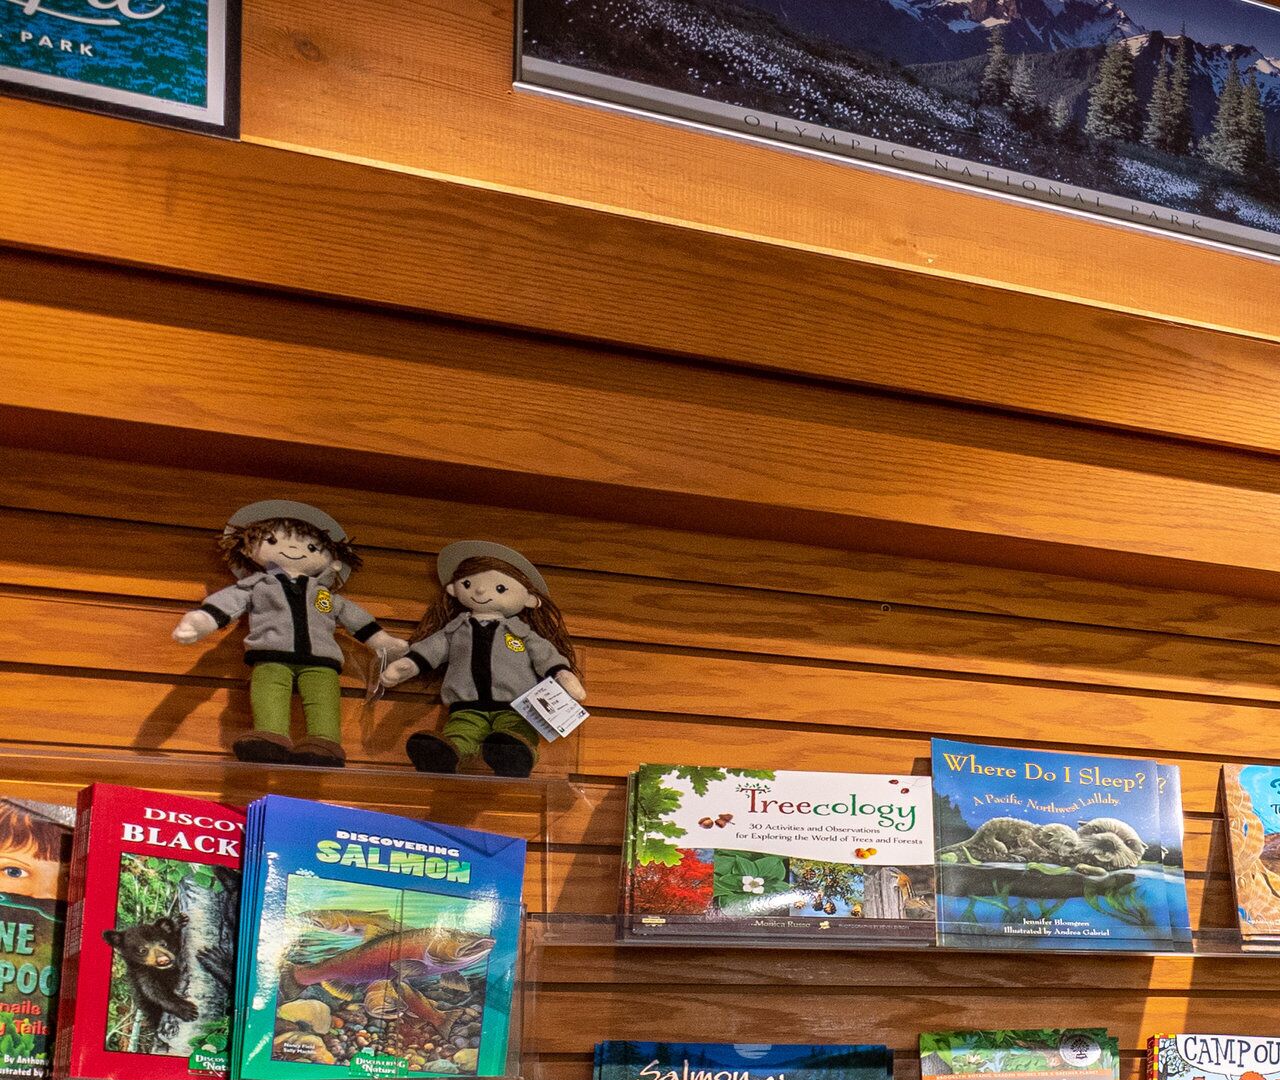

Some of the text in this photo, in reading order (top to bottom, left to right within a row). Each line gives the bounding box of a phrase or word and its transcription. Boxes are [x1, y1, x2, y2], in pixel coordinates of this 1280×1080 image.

[21, 31, 95, 58] PARK
[743, 114, 1202, 231] OLYMPIC NATIONAL PARK
[943, 753, 1148, 793] Where Do I Sleep?
[735, 783, 918, 832] Treecology
[121, 823, 240, 858] BLACK
[336, 830, 460, 858] DISCOVERING
[315, 840, 472, 885] SALMON
